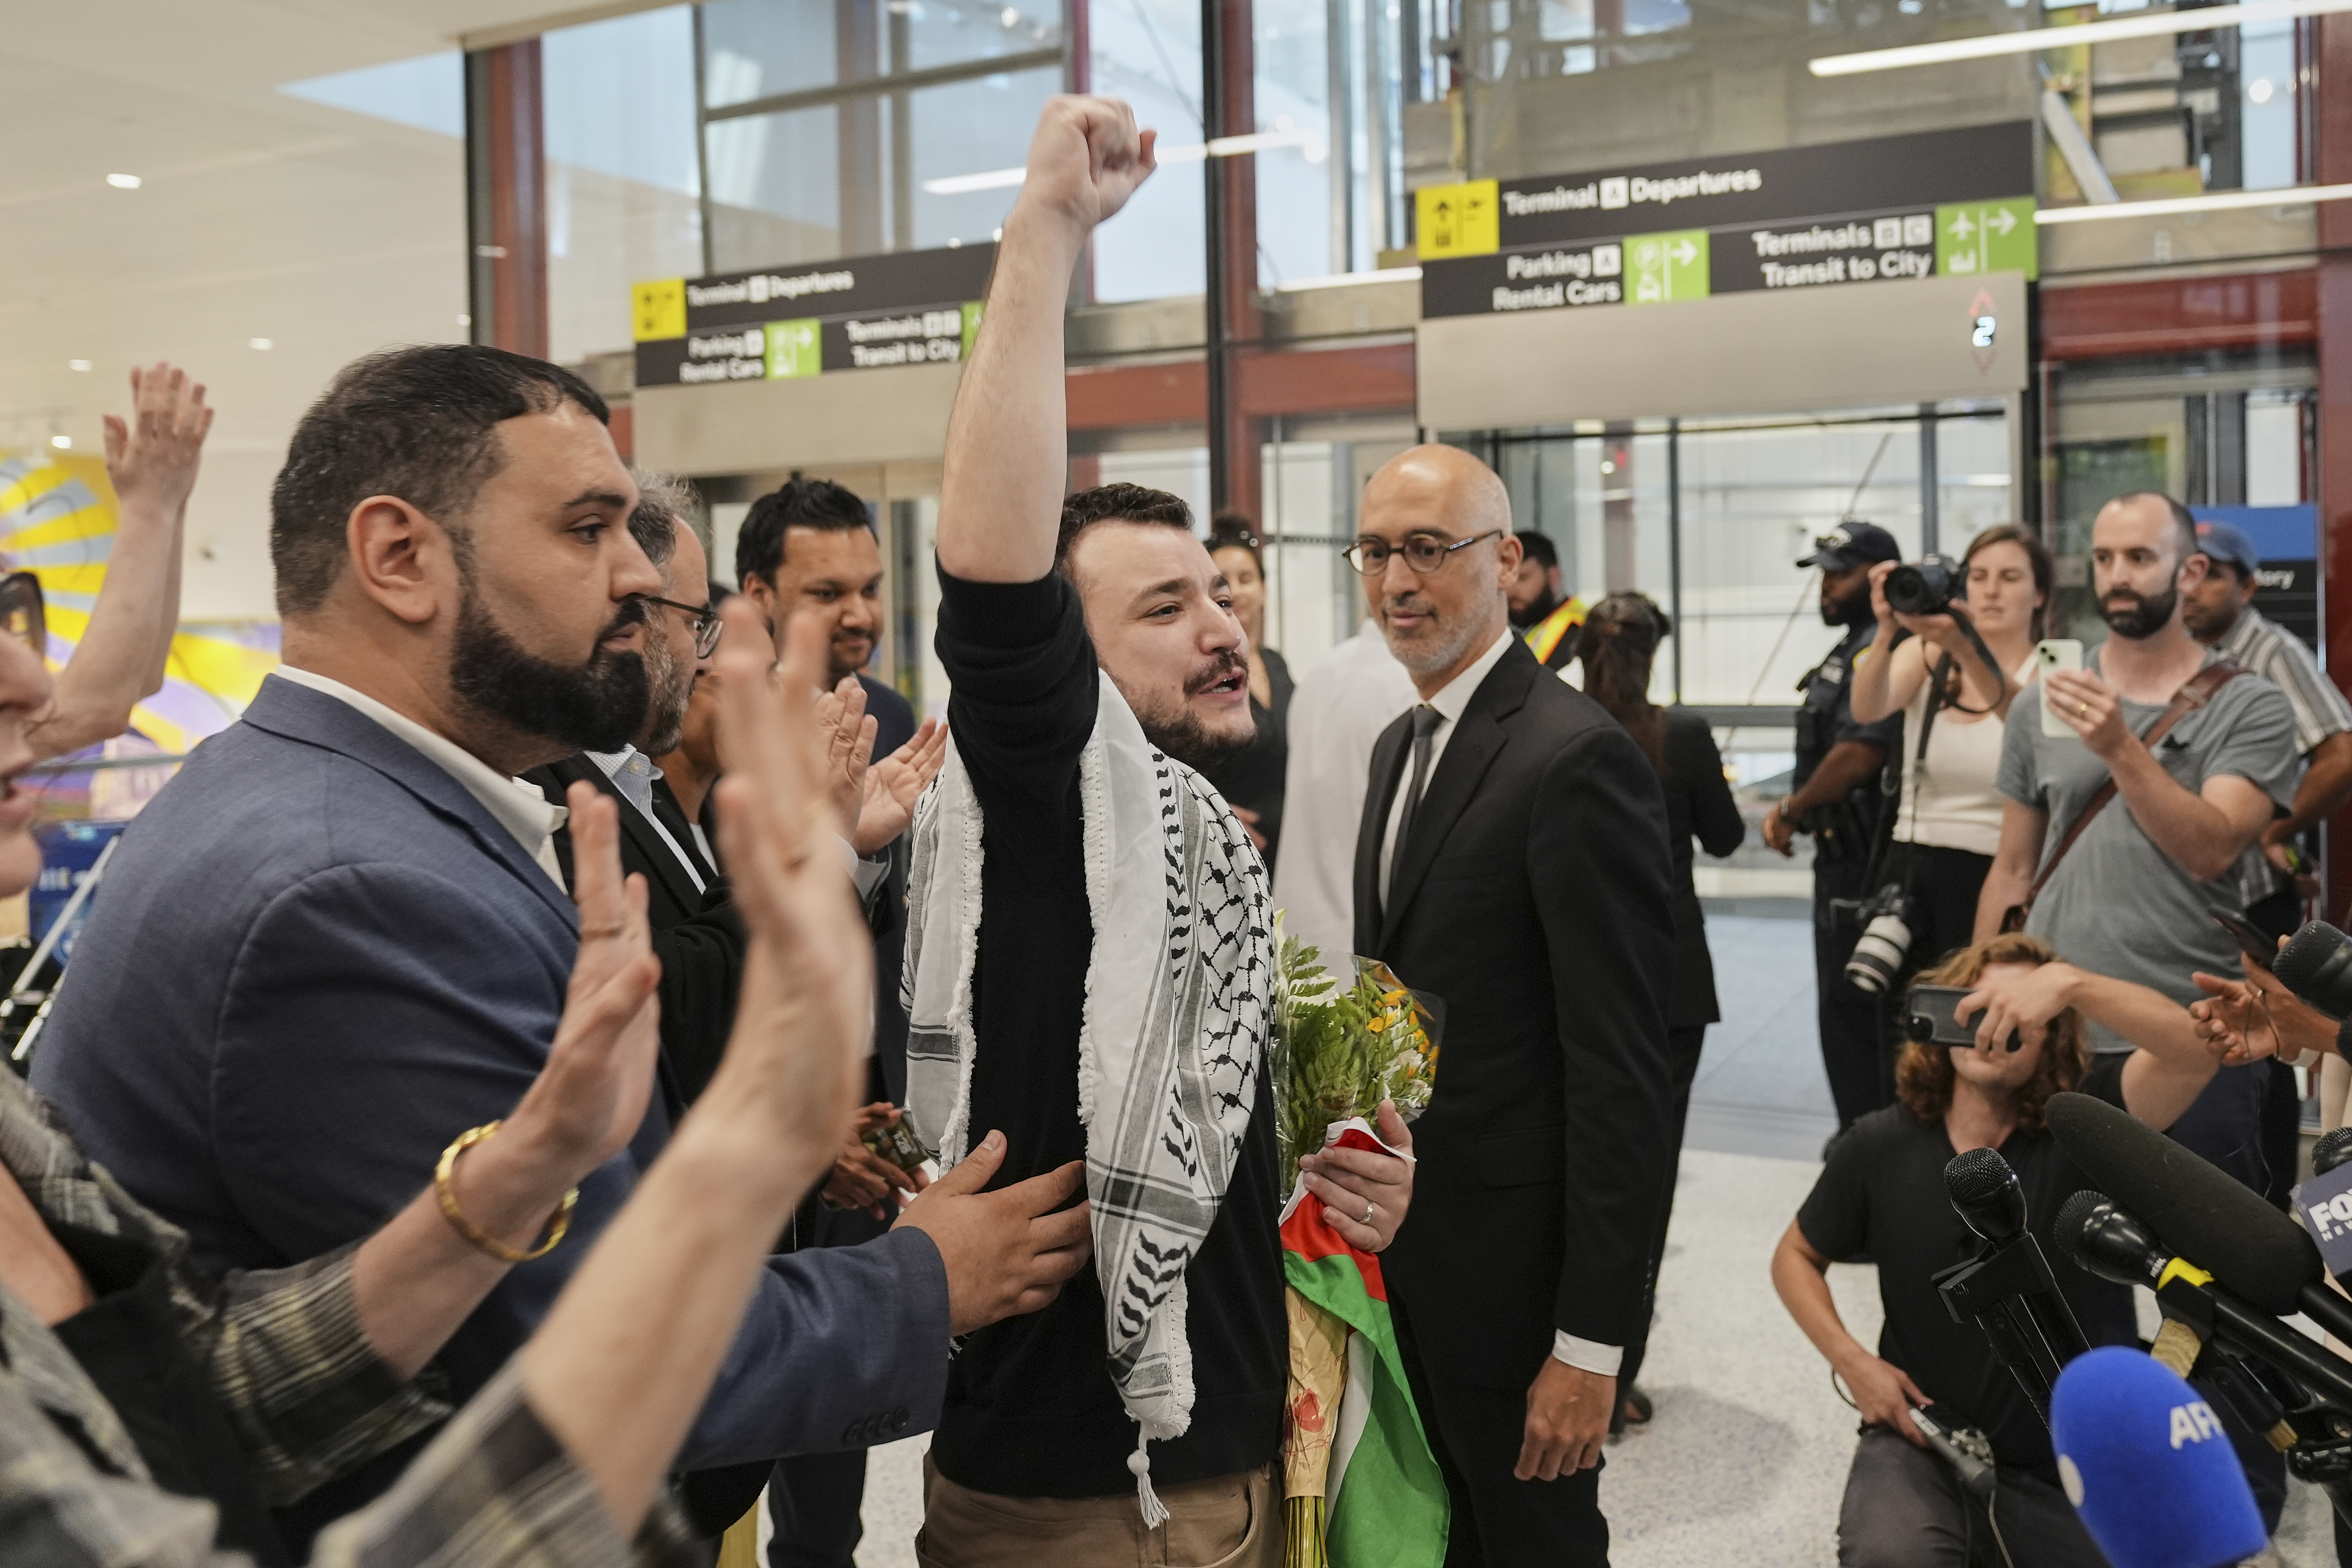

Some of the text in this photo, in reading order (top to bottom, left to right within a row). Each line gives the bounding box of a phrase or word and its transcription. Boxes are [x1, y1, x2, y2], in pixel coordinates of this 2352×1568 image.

[1503, 182, 1598, 216] Terminal
[1631, 169, 1762, 204] Departures
[1752, 222, 1872, 256] Terminals
[1507, 251, 1592, 280] Parking
[1761, 250, 1933, 288] Transit to City
[687, 278, 748, 307] Terminal
[770, 270, 855, 299] Departures
[1493, 279, 1620, 311] Rental Cars
[846, 315, 921, 342] Terminals
[1972, 316, 1996, 347] 2
[688, 334, 743, 358] Parking
[851, 338, 961, 367] Transit to City
[680, 357, 764, 383] Rental Cars
[2308, 1188, 2352, 1232] FO
